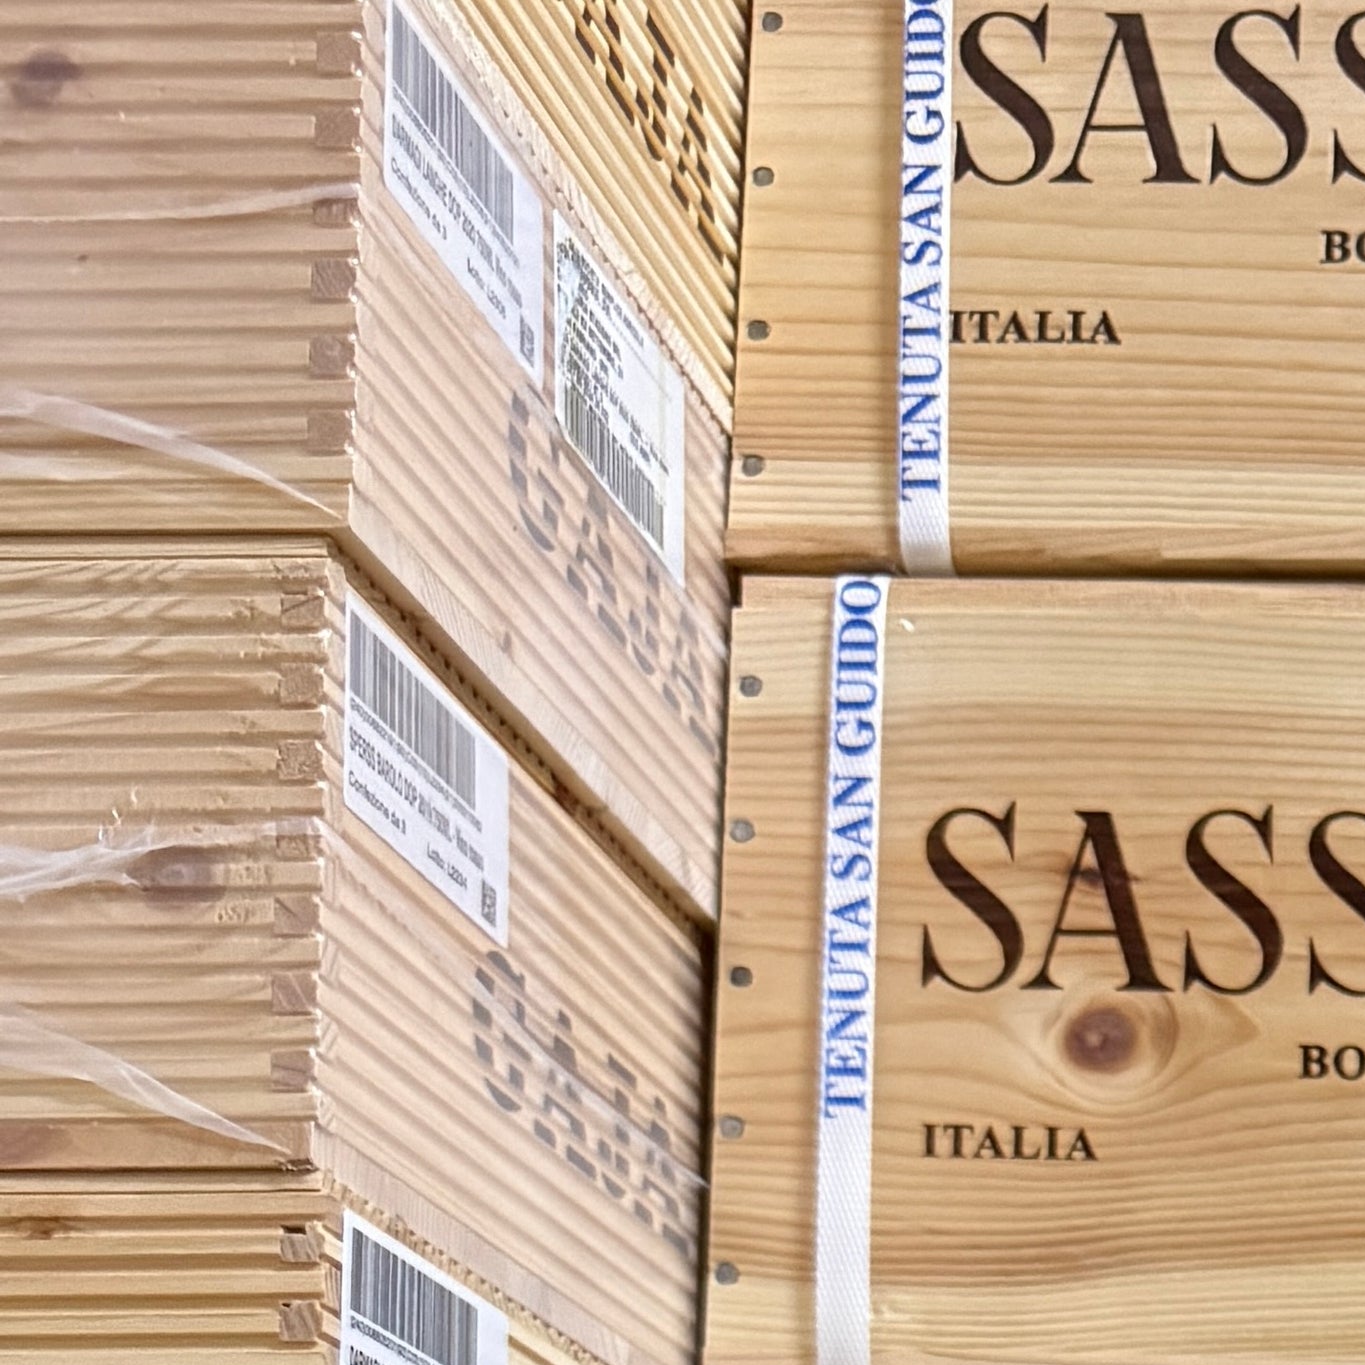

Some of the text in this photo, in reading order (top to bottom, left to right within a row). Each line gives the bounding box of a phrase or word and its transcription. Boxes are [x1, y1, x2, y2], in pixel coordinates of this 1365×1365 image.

[901, 0, 947, 501] TENUTA SAN GUID
[949, 309, 1122, 345] ITALIA
[822, 577, 884, 1119] TENUTA SAN GUIDO
[921, 1123, 1099, 1162] ITALIA
